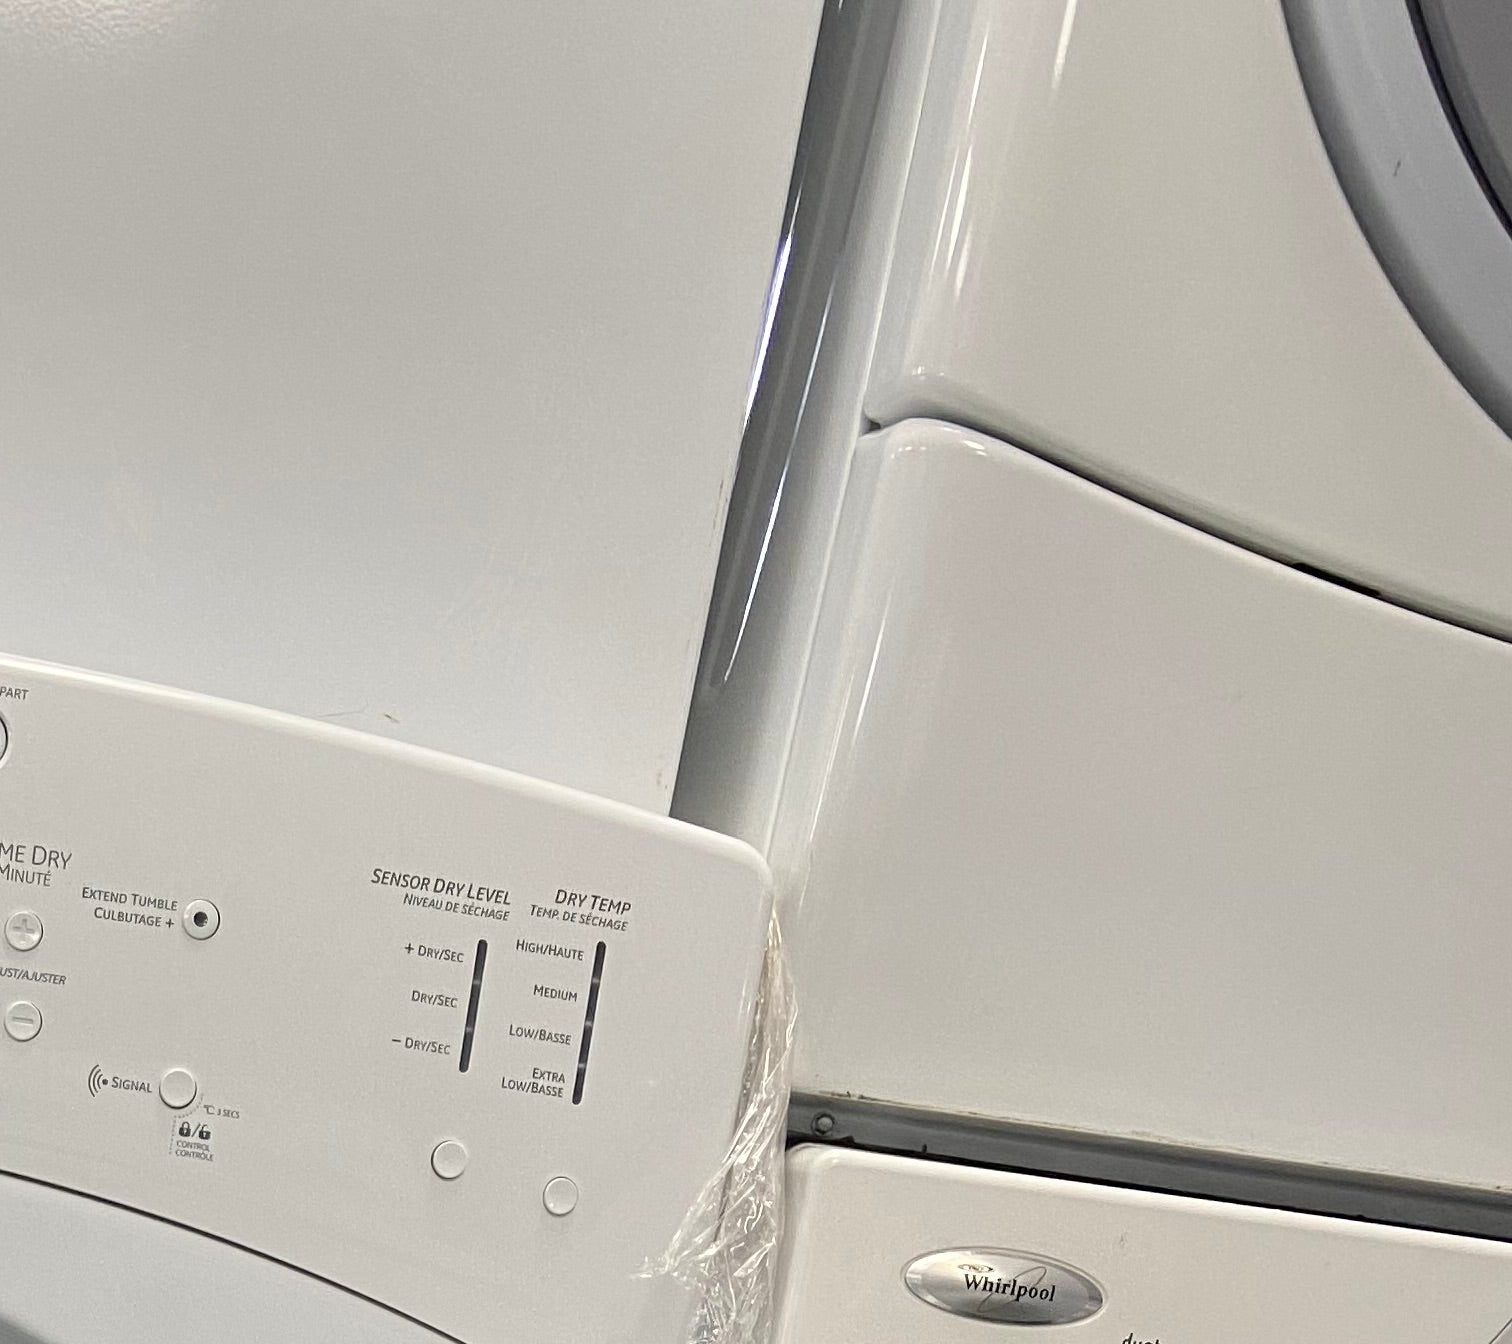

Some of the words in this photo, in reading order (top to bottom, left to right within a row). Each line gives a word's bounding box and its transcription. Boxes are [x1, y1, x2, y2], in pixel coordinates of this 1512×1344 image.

[30, 844, 73, 871] DRY
[81, 885, 129, 908] EXTEND
[131, 892, 178, 912] TUMBLE
[371, 868, 431, 893] SENSOR
[433, 877, 466, 899] DRY
[466, 883, 511, 906] LEVEL
[403, 892, 443, 913] NIVEAU
[445, 901, 460, 915] DE
[461, 901, 510, 922] SÉCHAGE
[554, 888, 587, 908] DRY
[590, 895, 632, 916] TEMP
[93, 906, 162, 929] CULBUTAGE
[562, 910, 578, 924] DE
[579, 911, 629, 933] SÉCHAGE
[417, 944, 465, 964] DRY/SEC
[515, 938, 585, 961] HIGH/HAUTE
[411, 989, 458, 1009] DRY/SEC
[533, 984, 578, 1003] MEDIUM
[404, 1036, 451, 1056] DRY/SEC
[508, 1023, 571, 1046] LOW/BASSE
[111, 1075, 152, 1094] SIGNAL
[501, 1076, 564, 1098] LOW/BASSE
[532, 1067, 566, 1084] EXTRA
[963, 1273, 1056, 1302] Whirlpool
